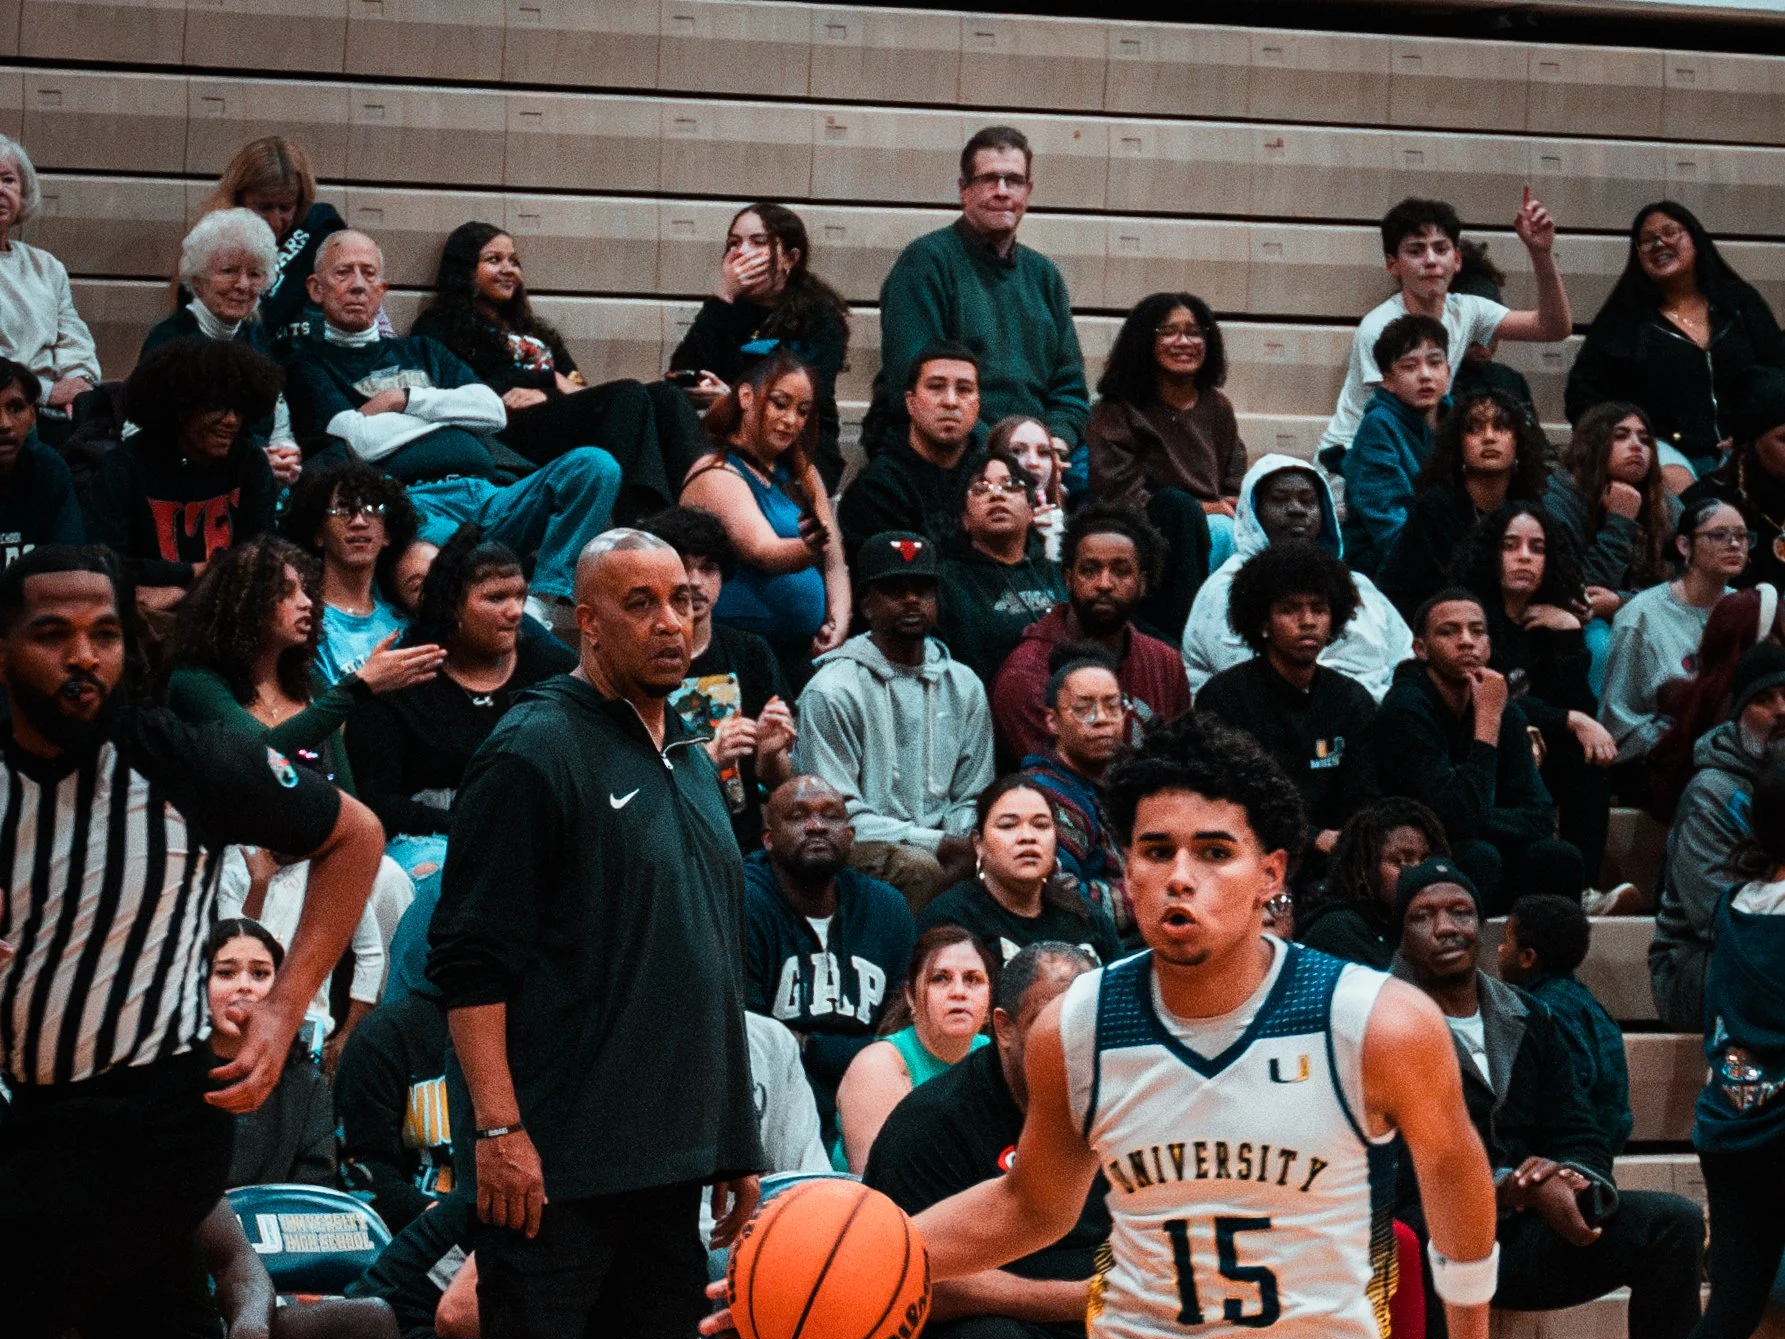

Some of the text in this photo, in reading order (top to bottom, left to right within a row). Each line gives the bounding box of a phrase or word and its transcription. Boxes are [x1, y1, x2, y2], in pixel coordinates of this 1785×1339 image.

[772, 951, 887, 1025] GAP
[1268, 1053, 1312, 1084] U
[1163, 1216, 1281, 1328] 15
